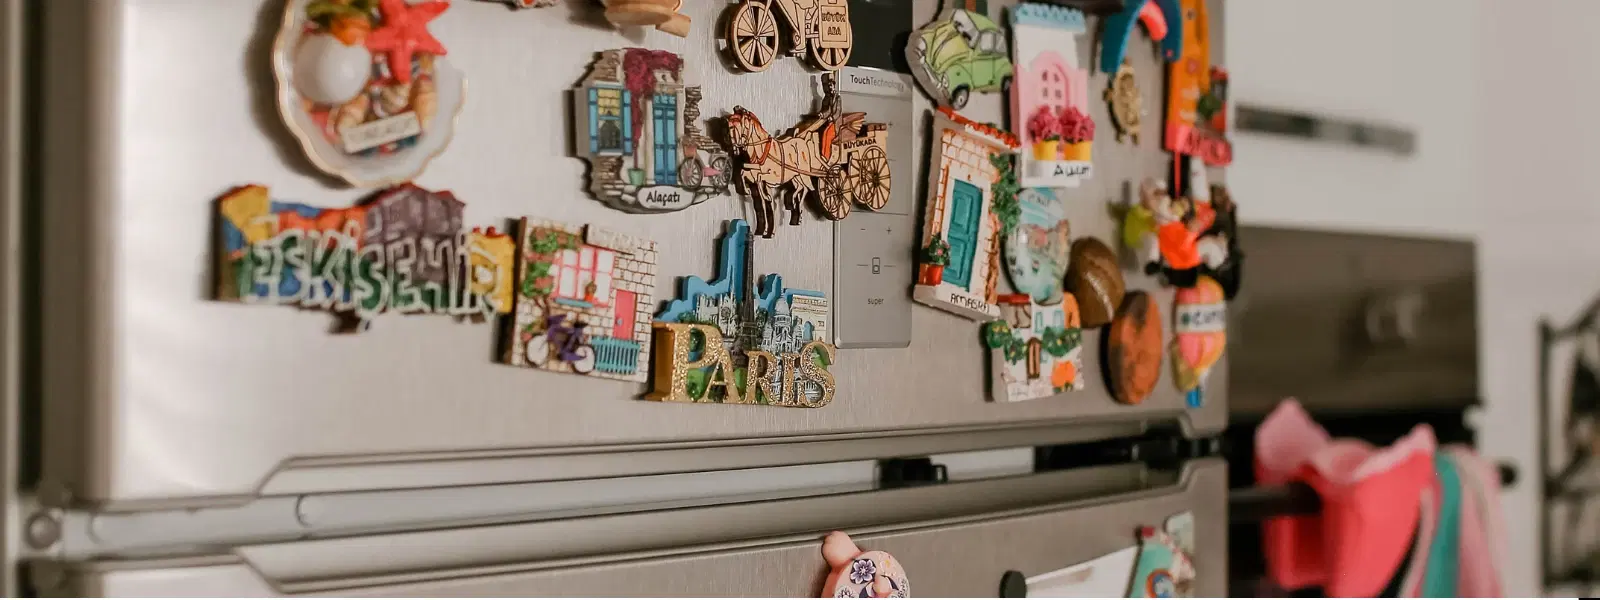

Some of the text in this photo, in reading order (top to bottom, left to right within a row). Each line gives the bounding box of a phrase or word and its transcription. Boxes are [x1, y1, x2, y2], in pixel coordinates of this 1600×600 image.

[827, 26, 841, 36] ADA
[646, 190, 681, 206] Alaçatı
[867, 298, 884, 307] super
[655, 323, 836, 408] PARIS
